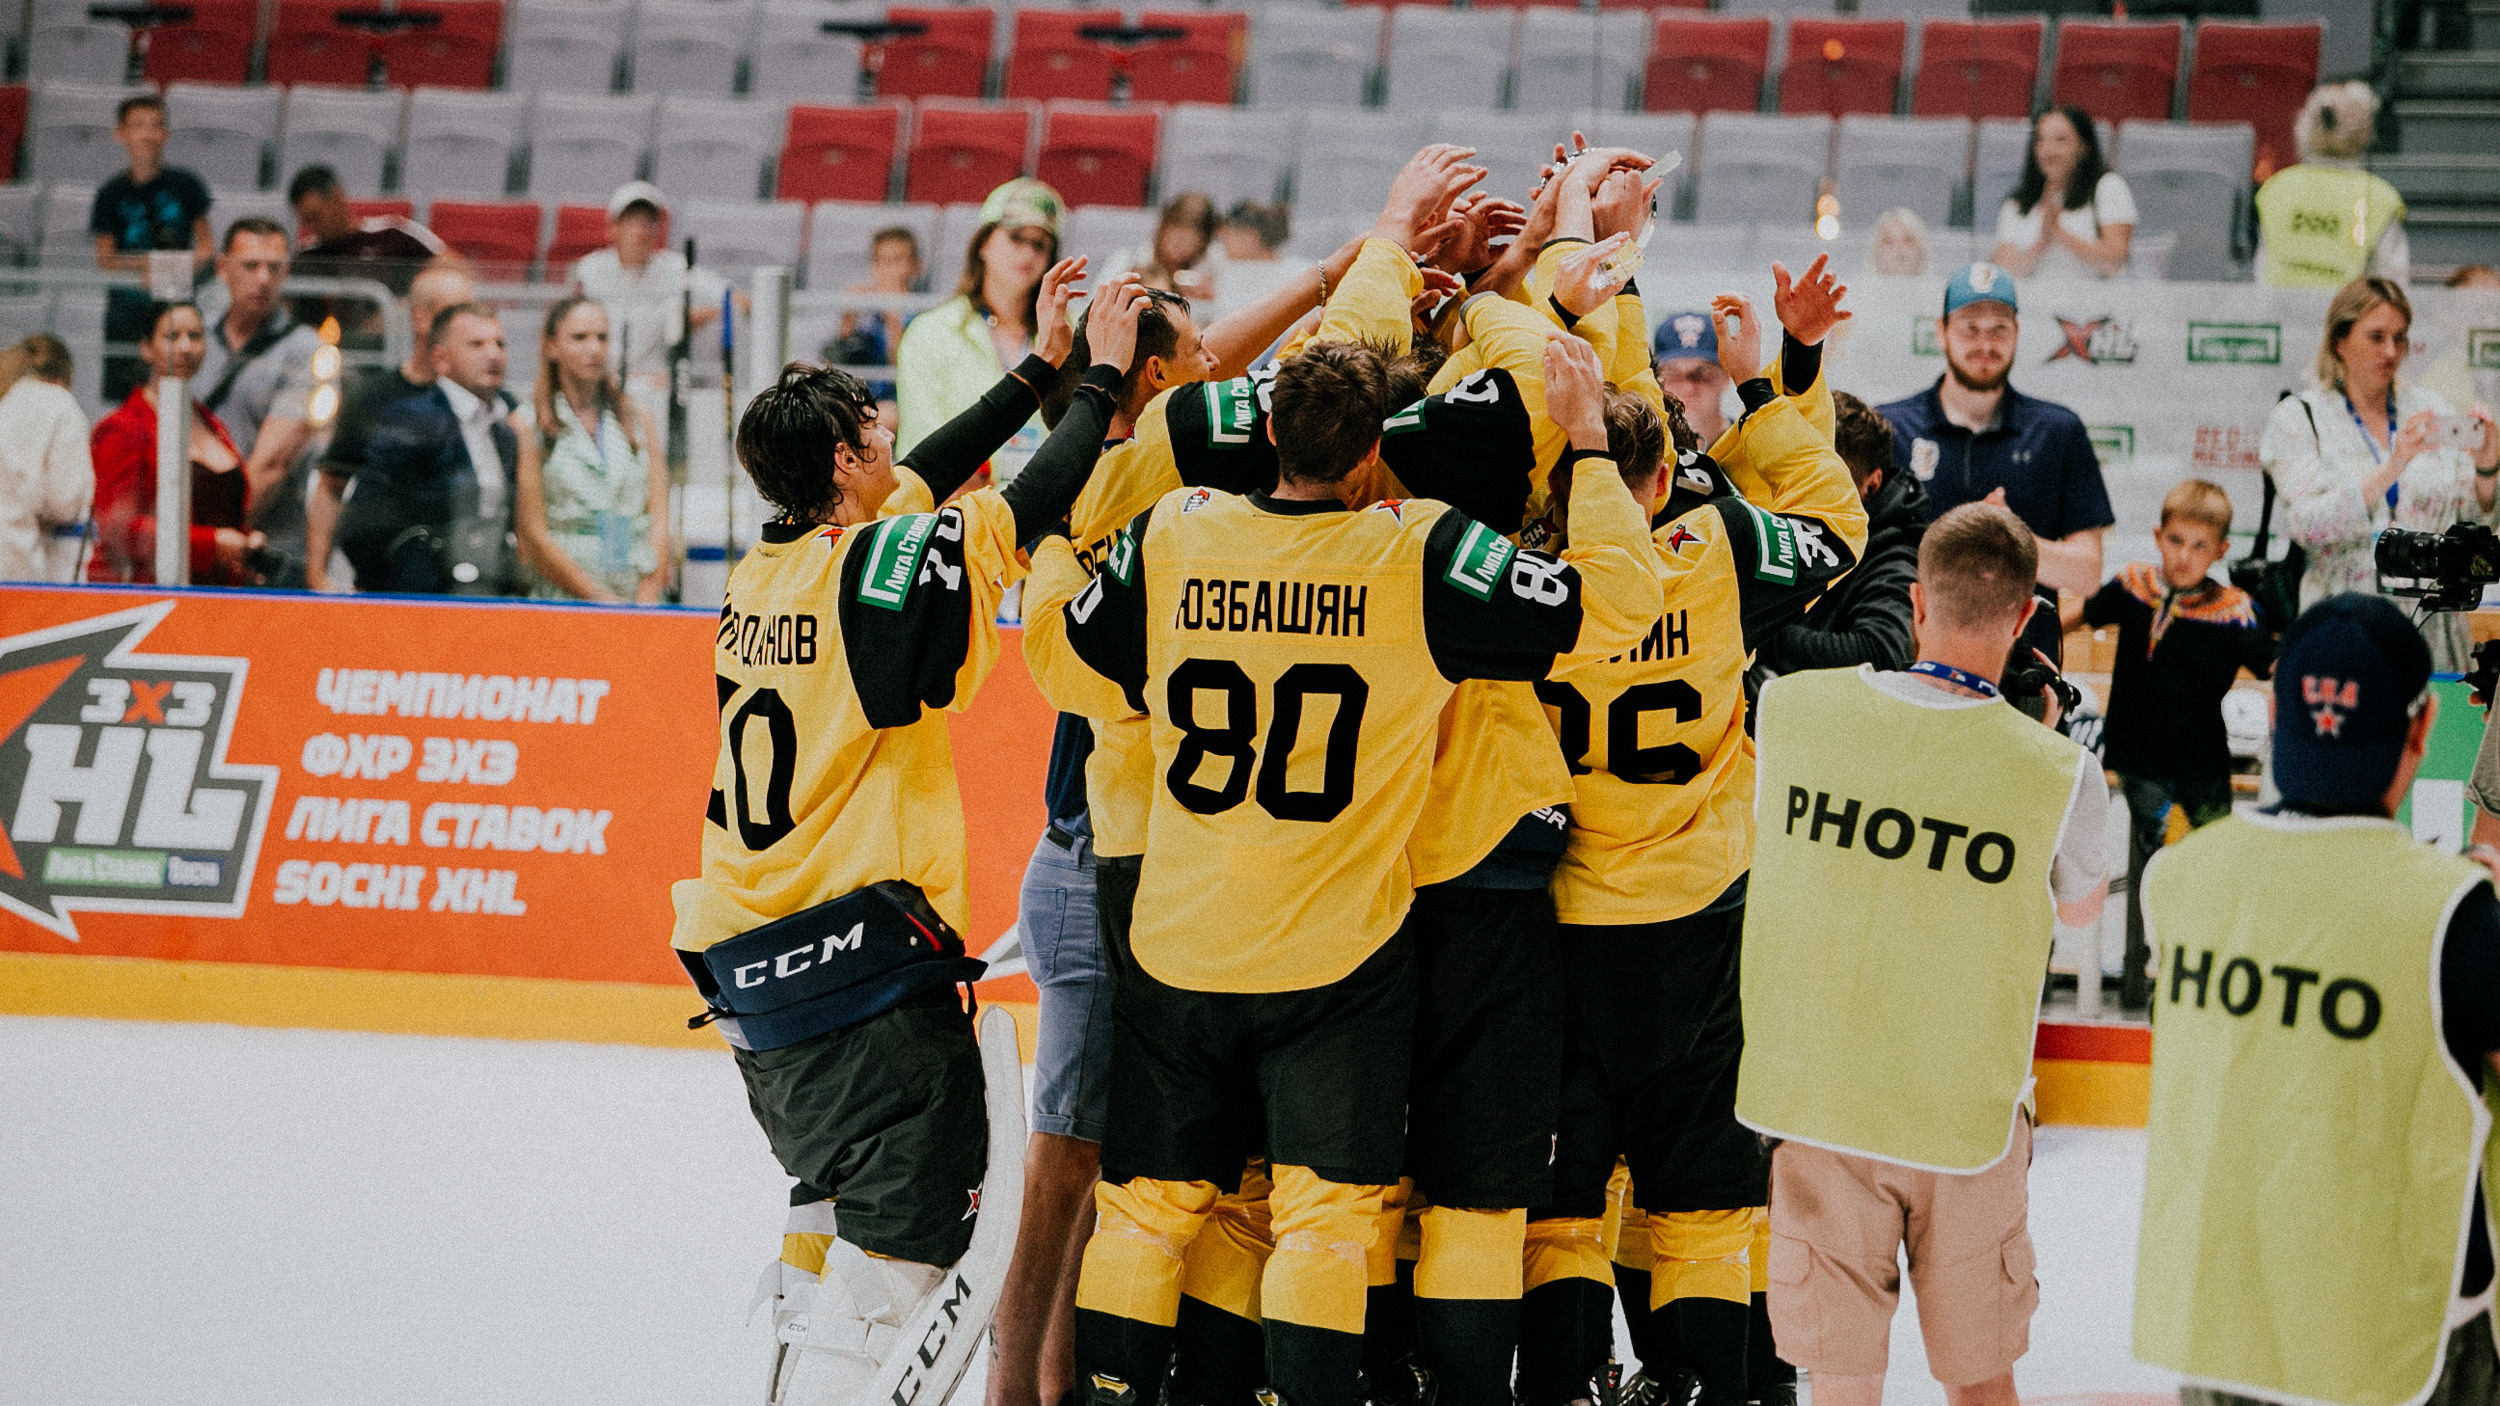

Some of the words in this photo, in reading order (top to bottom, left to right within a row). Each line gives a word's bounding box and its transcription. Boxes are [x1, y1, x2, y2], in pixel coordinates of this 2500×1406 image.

[1175, 577, 1368, 637] ЮЗБАШЯН
[316, 667, 610, 725] ЧЕМПИОНАТ
[302, 733, 412, 779] ФХР
[1166, 657, 1369, 823] 80
[285, 795, 411, 846] ЛИГА
[420, 801, 613, 855] СТАВОК
[1786, 785, 2016, 884] PHOTO
[273, 859, 425, 912] SOCHI
[429, 866, 527, 916] XHL
[734, 922, 864, 989] CCM
[2170, 945, 2383, 1042] HOTO
[892, 1273, 972, 1406] CCM
